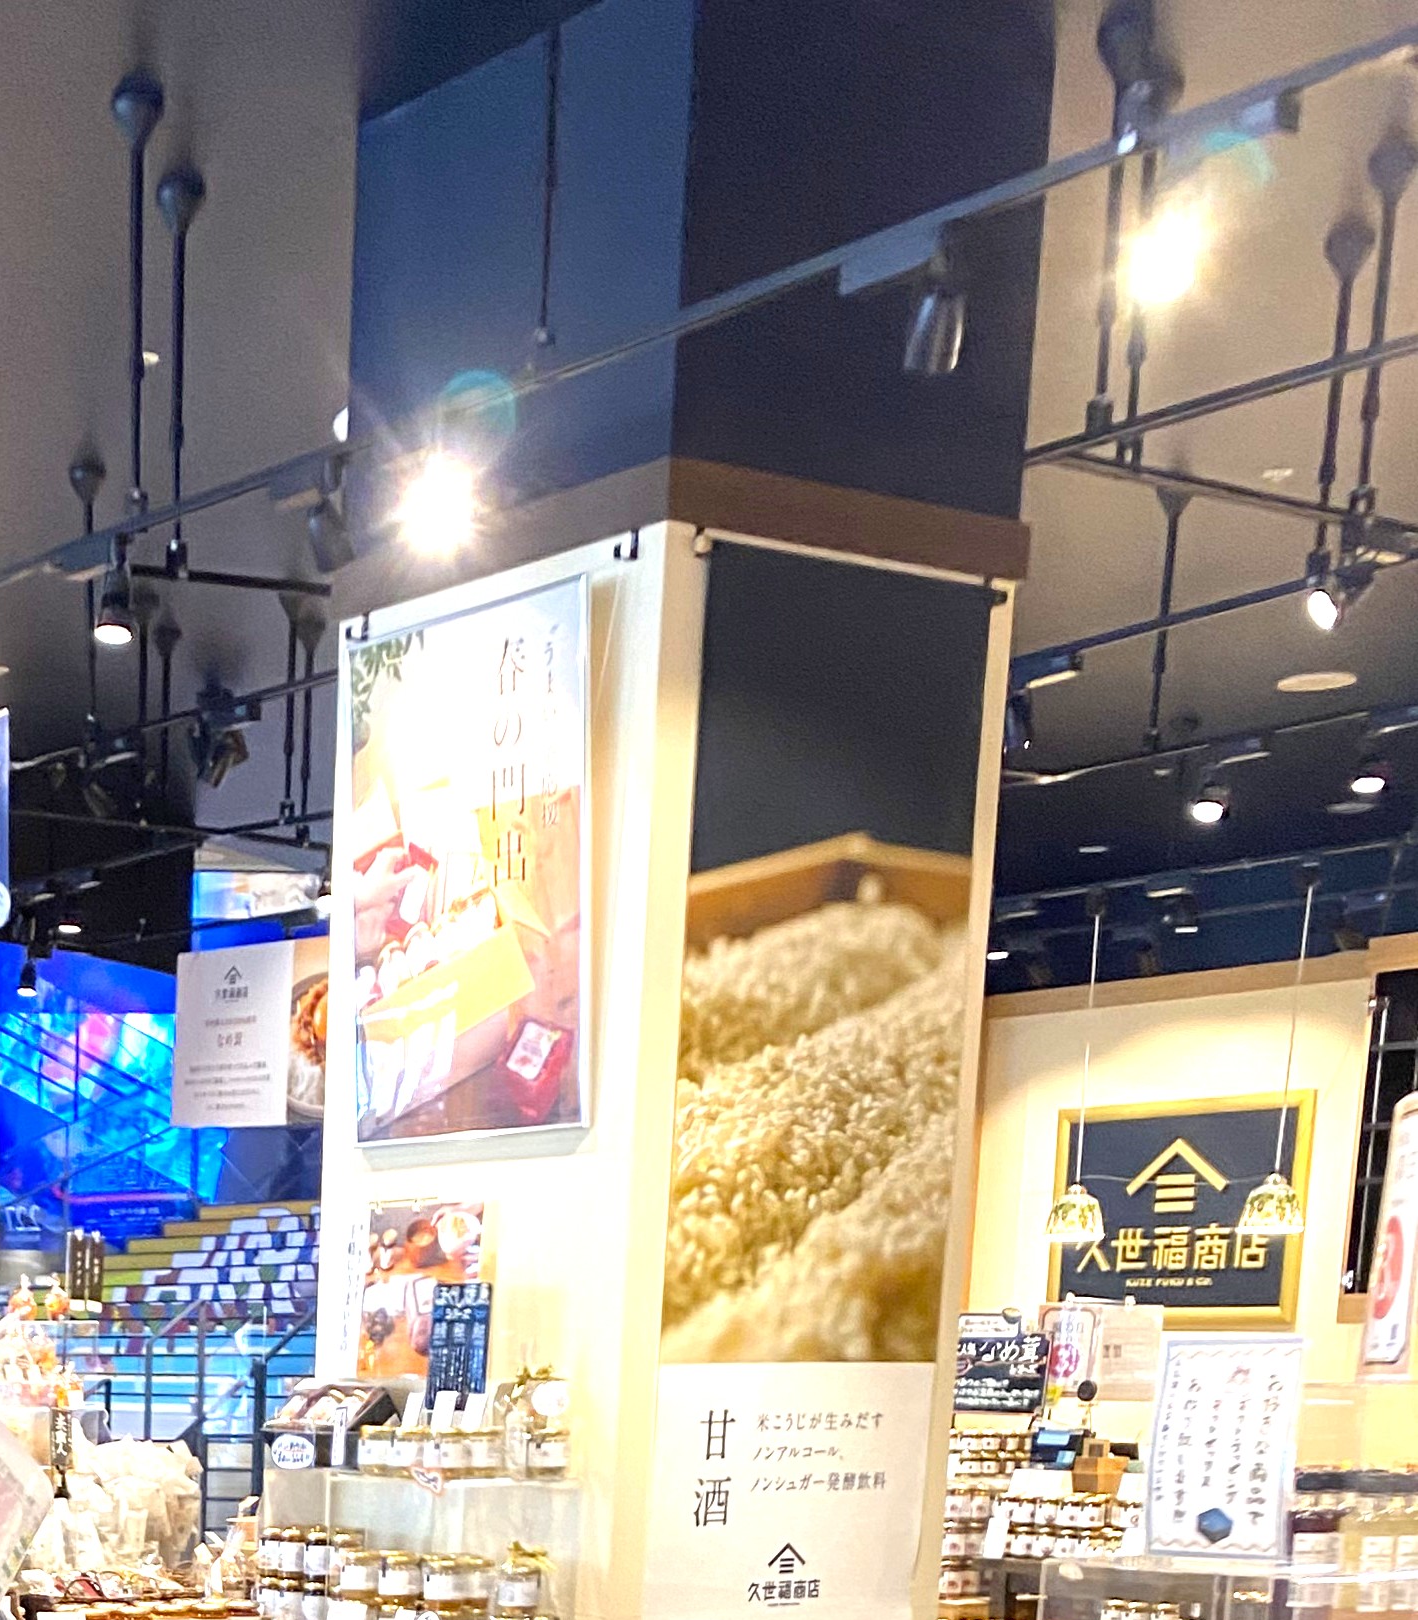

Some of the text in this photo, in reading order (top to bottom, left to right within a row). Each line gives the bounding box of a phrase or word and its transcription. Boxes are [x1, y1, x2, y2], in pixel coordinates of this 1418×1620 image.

[1075, 1223, 1270, 1273] 久世福商店
[756, 1411, 885, 1432] 米こうじが生みだす
[692, 1408, 736, 1527] 甘酒
[749, 1471, 888, 1493] ノンシュガー発酵飲料
[747, 1579, 821, 1603] 久世福商店
